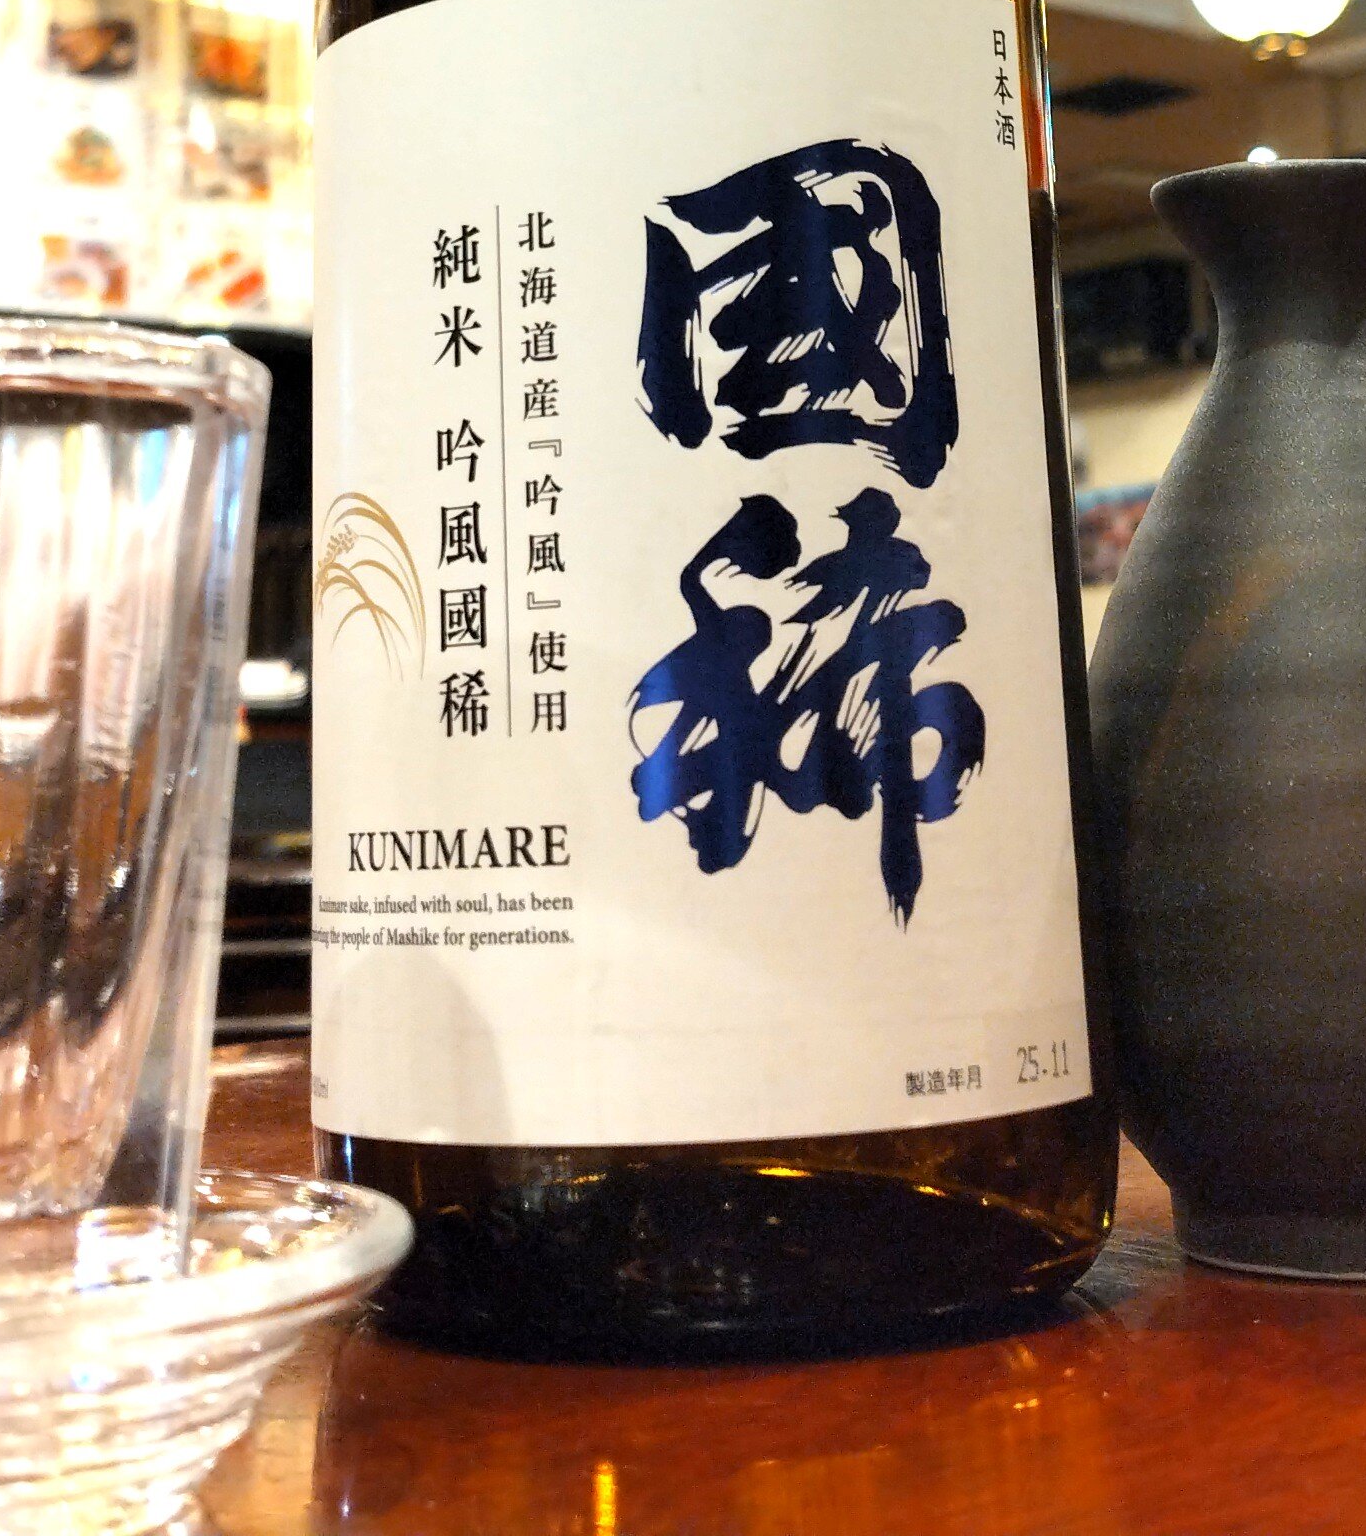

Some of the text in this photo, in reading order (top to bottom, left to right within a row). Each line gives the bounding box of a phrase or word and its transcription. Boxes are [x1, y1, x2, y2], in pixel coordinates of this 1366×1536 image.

[991, 29, 1017, 152] 日本酒
[517, 210, 570, 734] 北海道産『吟風』使用
[348, 824, 571, 872] KUNIMARE
[349, 894, 372, 915] sake,
[373, 894, 417, 914] infused
[420, 894, 452, 914] with
[455, 892, 493, 915] soul,
[497, 891, 526, 912] has
[530, 891, 574, 912] been
[341, 926, 371, 951] people
[372, 926, 386, 946] of
[386, 926, 440, 947] Mashike
[443, 926, 465, 946] for
[469, 925, 575, 951] generations.
[905, 1038, 1069, 1097] 製造年月 25.11
